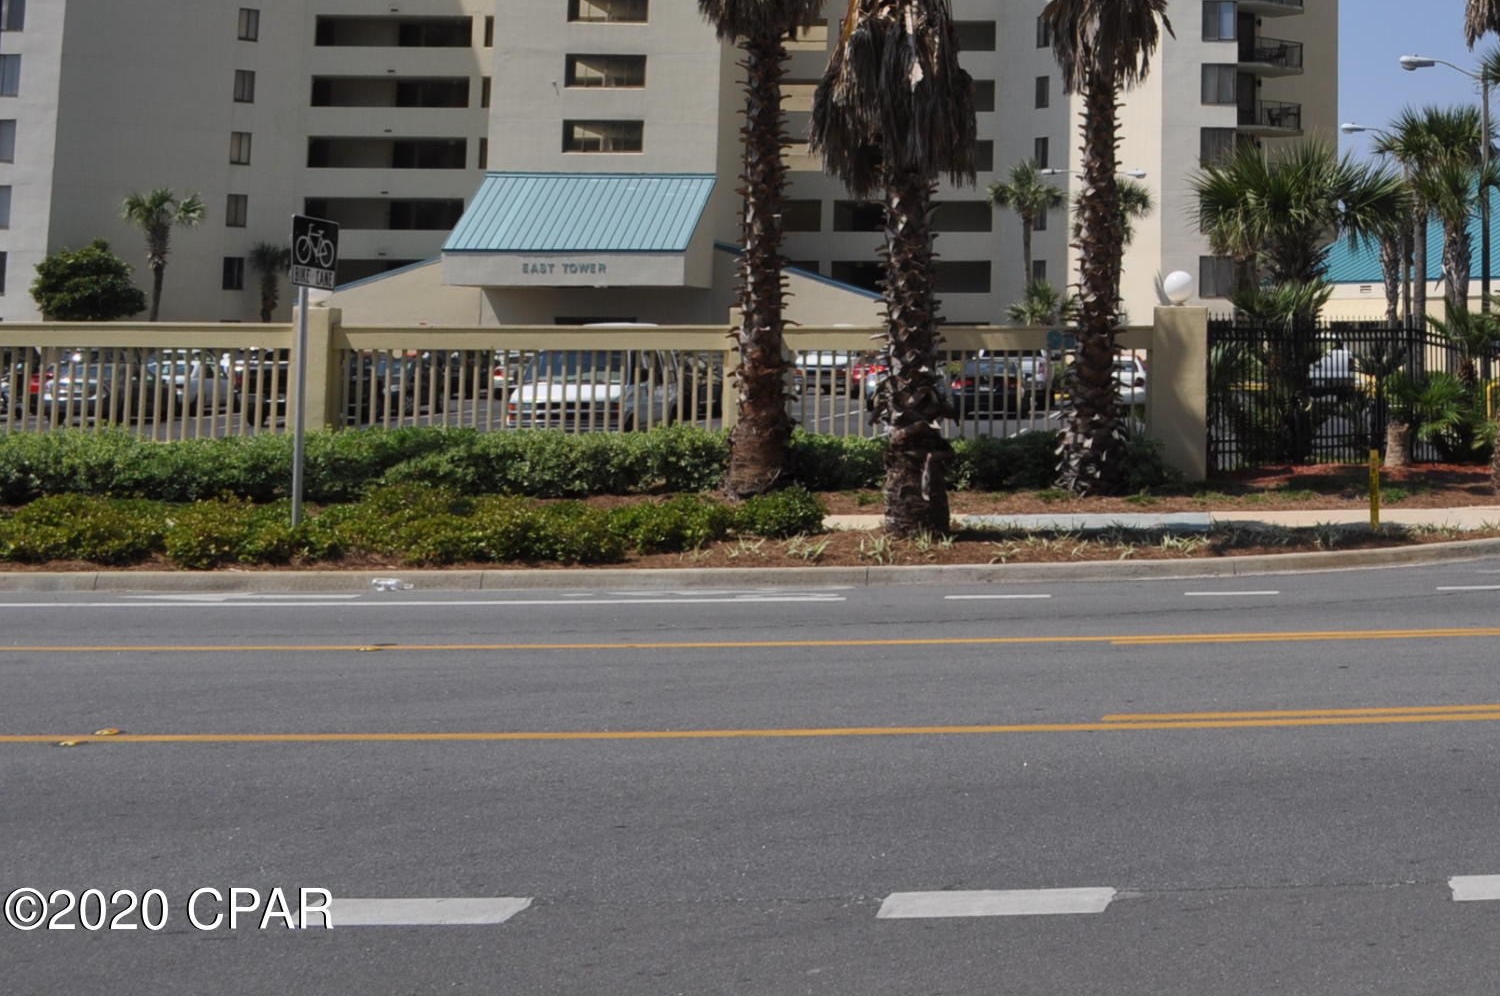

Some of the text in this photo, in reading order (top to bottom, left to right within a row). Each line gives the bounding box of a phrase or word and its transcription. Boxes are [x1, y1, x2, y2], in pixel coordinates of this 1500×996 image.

[522, 262, 607, 274] EAST TOWER
[295, 266, 332, 287] BIKE LANE
